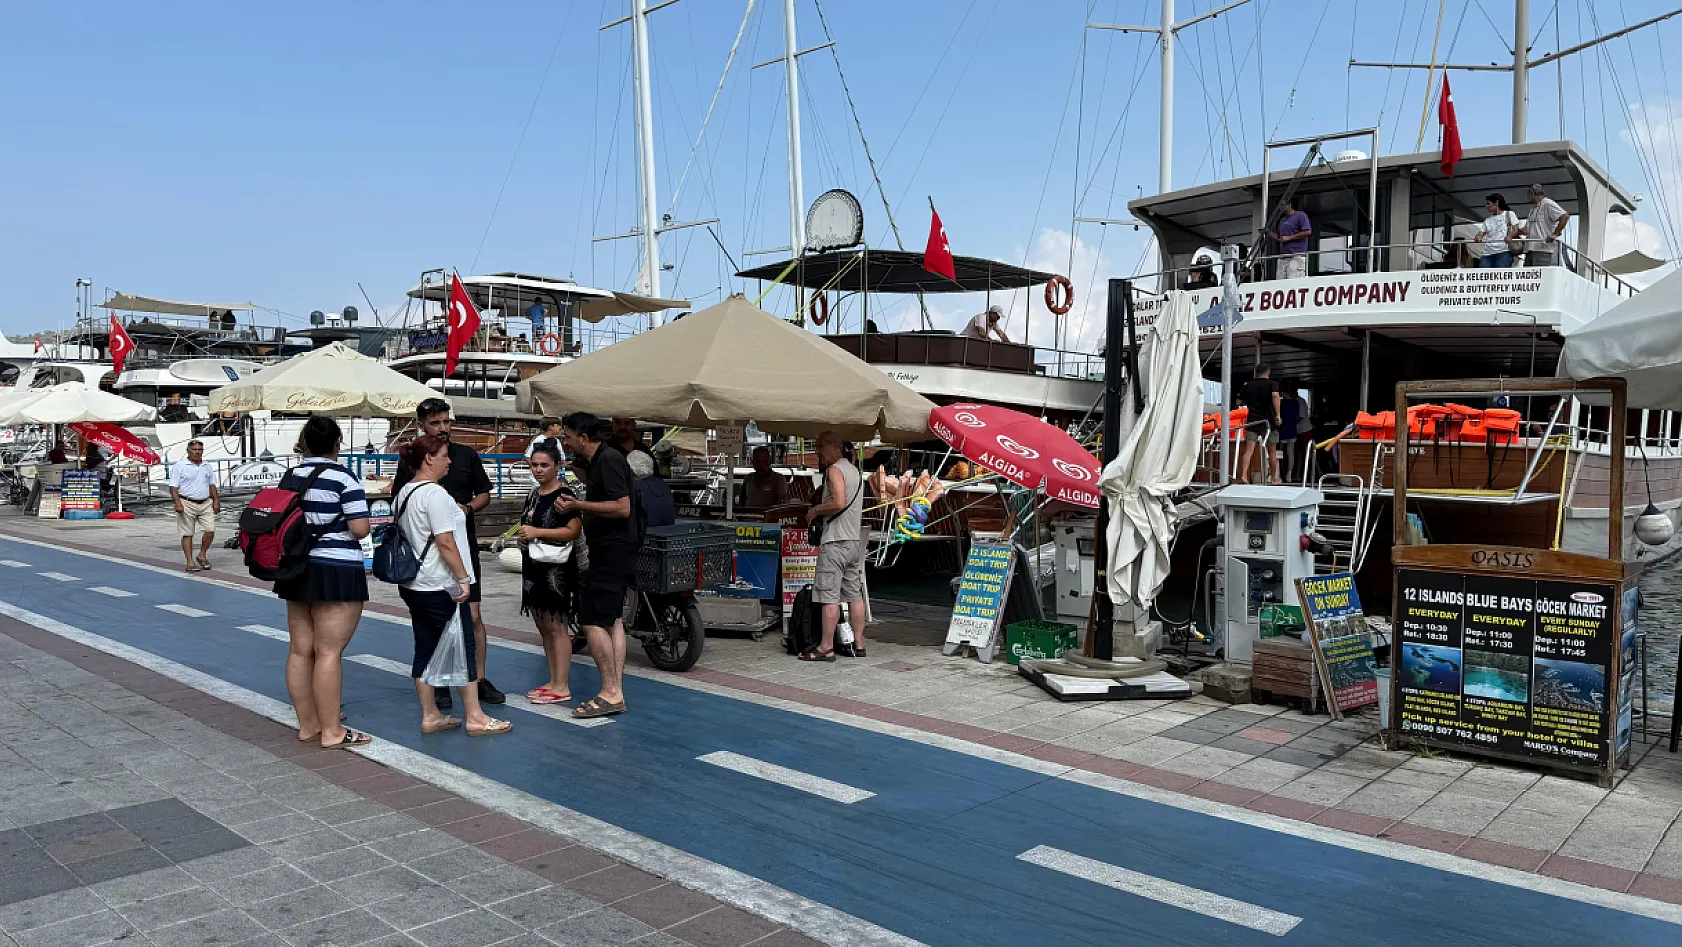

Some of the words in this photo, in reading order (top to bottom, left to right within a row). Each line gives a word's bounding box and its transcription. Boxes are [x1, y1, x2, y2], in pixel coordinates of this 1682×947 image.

[1466, 271, 1513, 281] KELEBEKLER
[1466, 283, 1510, 294] BUTTERFLY
[1511, 282, 1541, 293] VALLEY
[1260, 288, 1310, 312] BOAT
[1314, 281, 1411, 308] COMPANY
[1438, 297, 1471, 306] PRIVATE
[1472, 296, 1494, 305] BOAT
[1495, 296, 1521, 305] TOURS
[980, 549, 1012, 560] ISLANDS
[1471, 550, 1533, 567] OASIS
[968, 558, 988, 567] BOAT
[990, 560, 1008, 569] TRIP
[961, 580, 982, 591] BOAT
[983, 583, 1001, 593] TRIP
[1327, 576, 1353, 593] MARKET
[960, 594, 994, 606] PRIVATE
[1403, 587, 1417, 601] 12
[1418, 588, 1465, 606] ISLANDS
[1466, 593, 1498, 609] BLUE
[1500, 595, 1533, 613] BAYS
[955, 605, 975, 614] BOAT
[977, 606, 996, 617] TRIP
[1408, 607, 1459, 620] EVERYDAY
[1536, 597, 1567, 615] GÖCEK
[1568, 602, 1607, 619] MARKET
[1472, 613, 1527, 627] EVERYDAY
[1540, 616, 1567, 625] EVERY
[1568, 619, 1600, 629] SUNDAY
[1543, 624, 1596, 639] (REGULARLY)
[1489, 639, 1513, 649] 17:30
[1560, 638, 1585, 647] 11:00
[1560, 647, 1586, 657] 17:45
[1402, 711, 1422, 722] Pick
[1424, 716, 1437, 725] up
[1438, 718, 1474, 730] service
[1476, 722, 1500, 734] from
[1501, 729, 1526, 738] your
[1527, 731, 1554, 742] hotel
[1557, 737, 1568, 745] or
[1570, 739, 1600, 749] villas
[1560, 746, 1599, 761] Company
